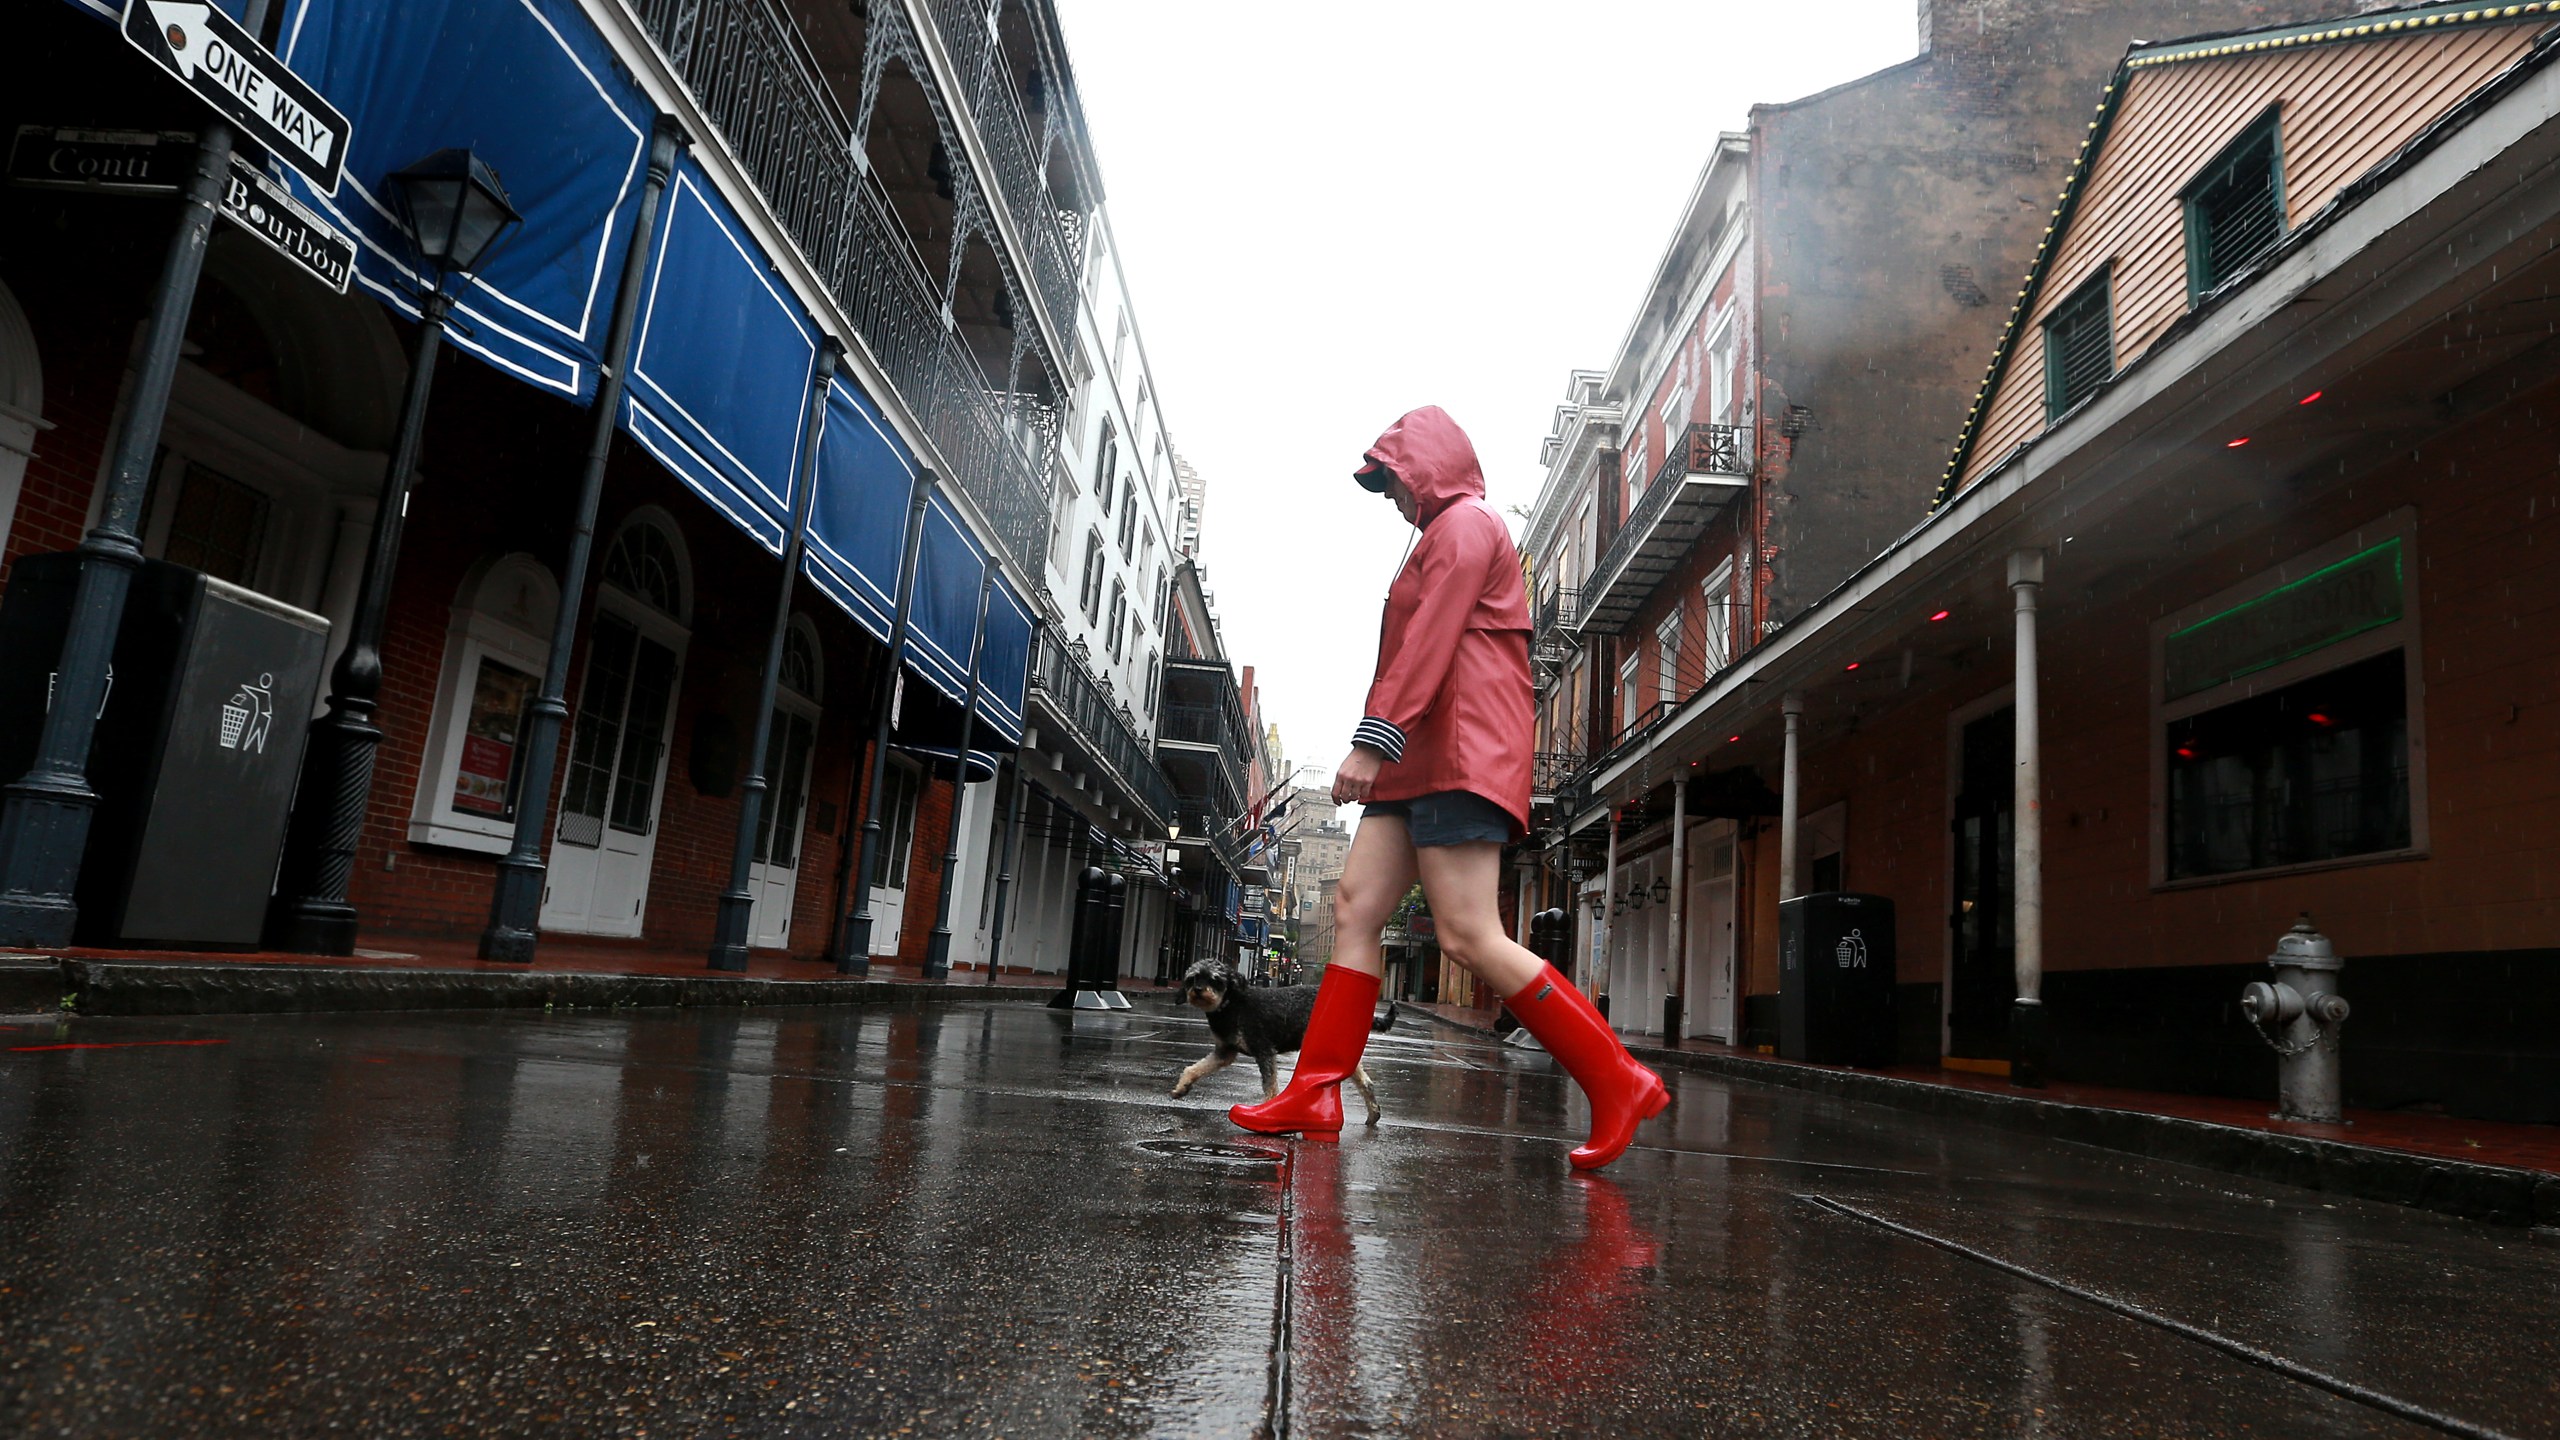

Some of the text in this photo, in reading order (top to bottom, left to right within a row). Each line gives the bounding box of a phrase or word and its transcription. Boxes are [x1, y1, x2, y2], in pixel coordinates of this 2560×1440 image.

[205, 40, 326, 154] ONE WAY
[48, 147, 153, 179] Conti
[225, 176, 345, 283] Bourbon
[264, 182, 326, 234] Rue Bourbon
